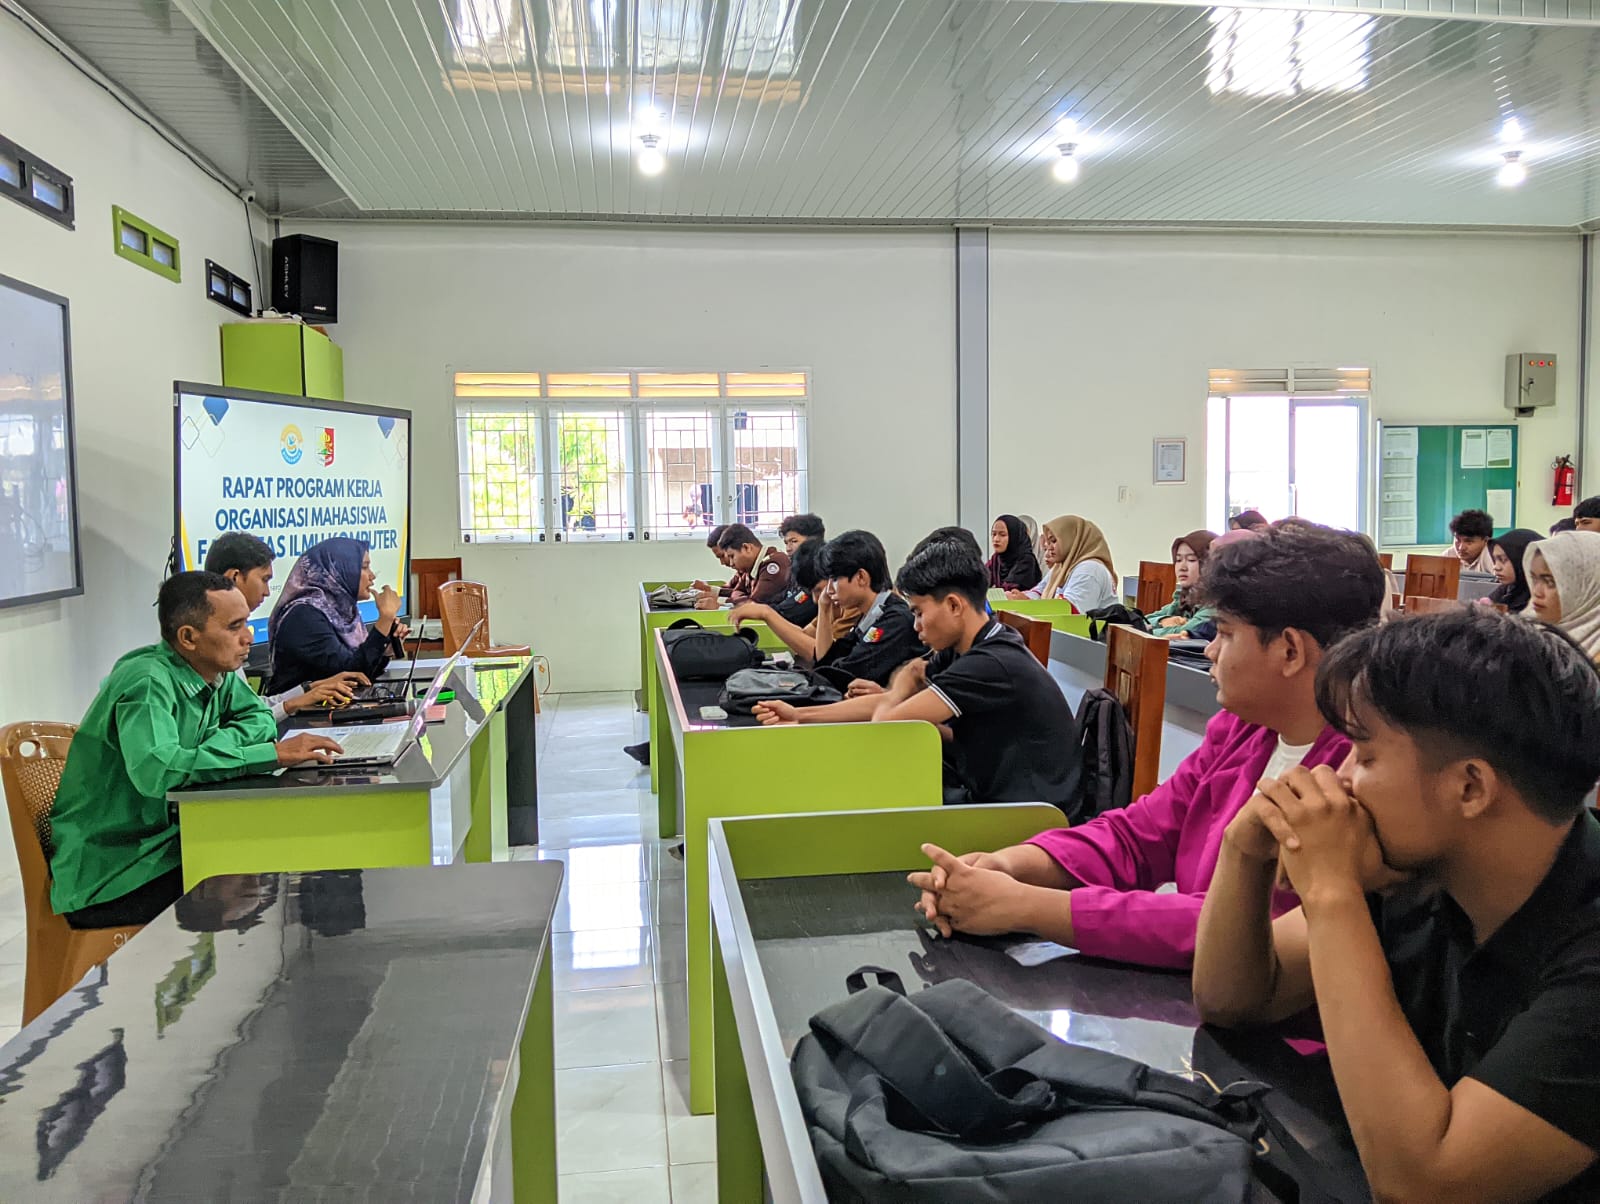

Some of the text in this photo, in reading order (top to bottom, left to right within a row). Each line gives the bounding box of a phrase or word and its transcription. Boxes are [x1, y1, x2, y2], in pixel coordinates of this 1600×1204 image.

[223, 476, 383, 499] RAPAT PROGRAM KERJA
[215, 505, 388, 531] ORGANISASI MAHASISWA
